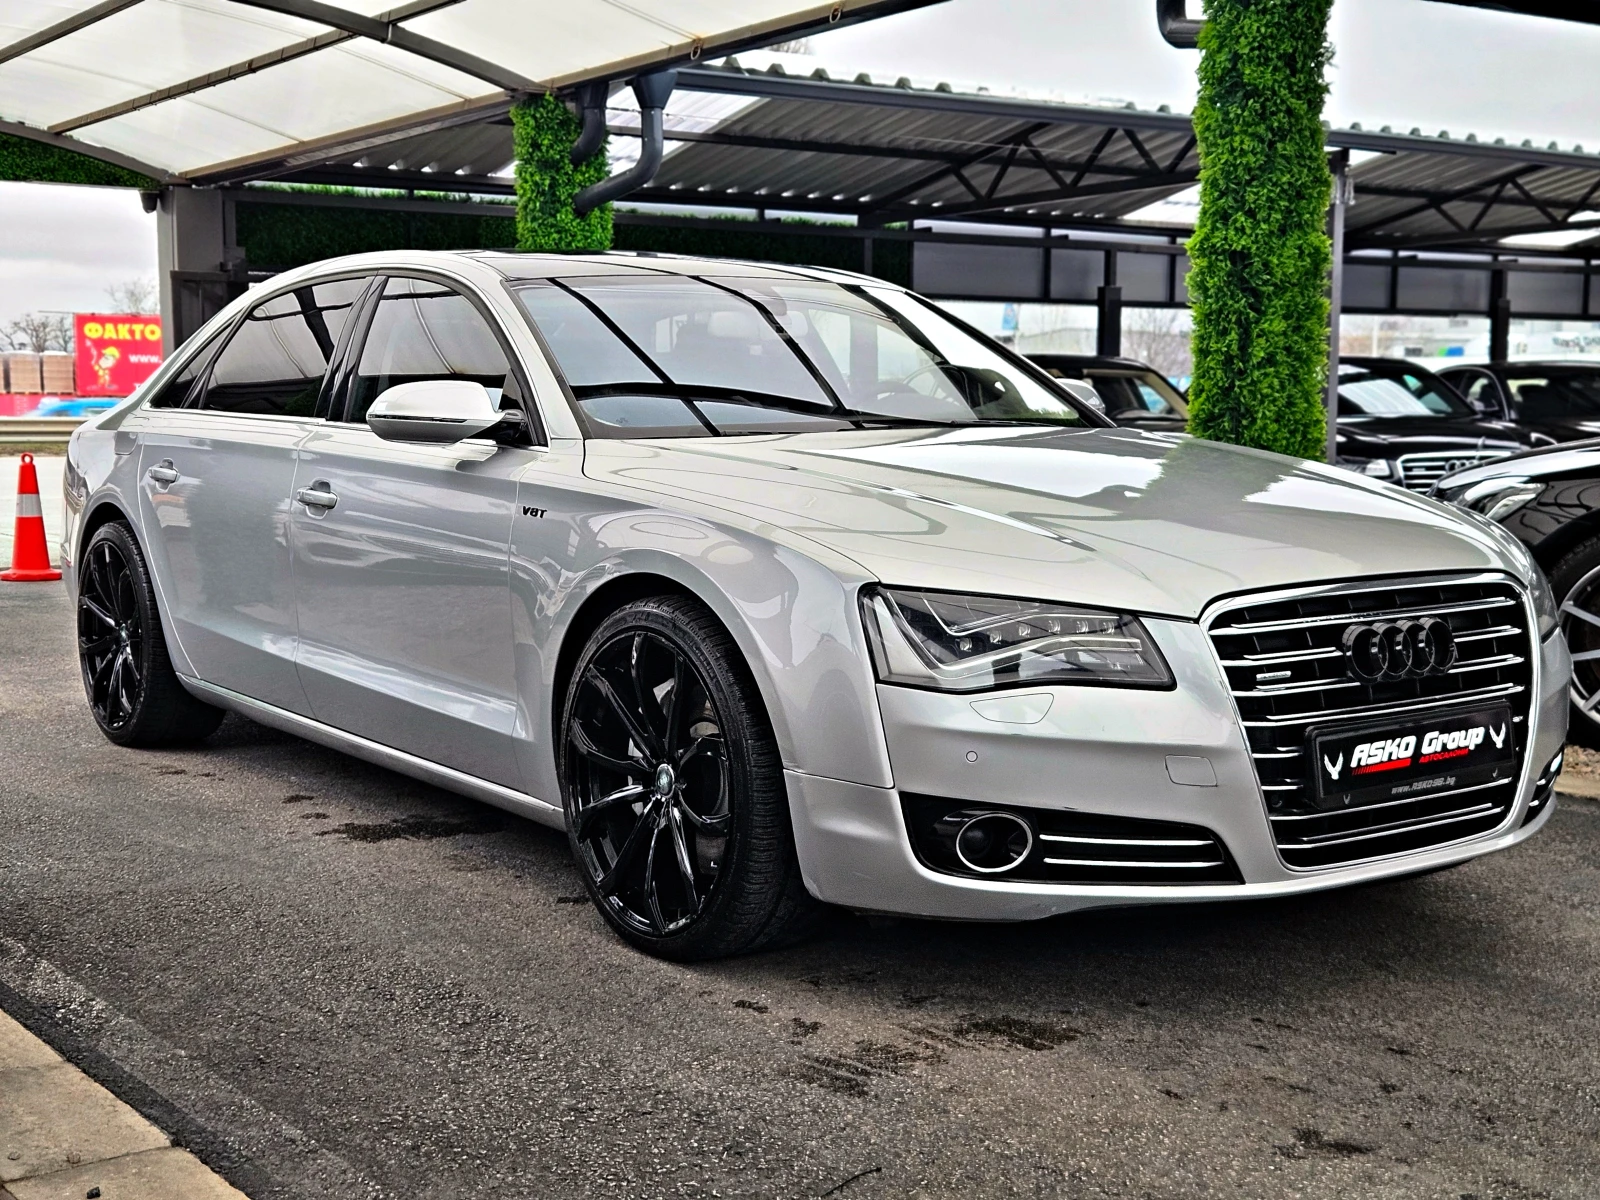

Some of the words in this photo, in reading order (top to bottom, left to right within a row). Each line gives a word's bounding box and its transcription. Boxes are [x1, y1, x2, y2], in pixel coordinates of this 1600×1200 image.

[84, 322, 161, 340] ФАКТО
[522, 506, 547, 518] V8T
[1350, 735, 1417, 767] ASKO
[1421, 726, 1485, 754] Group
